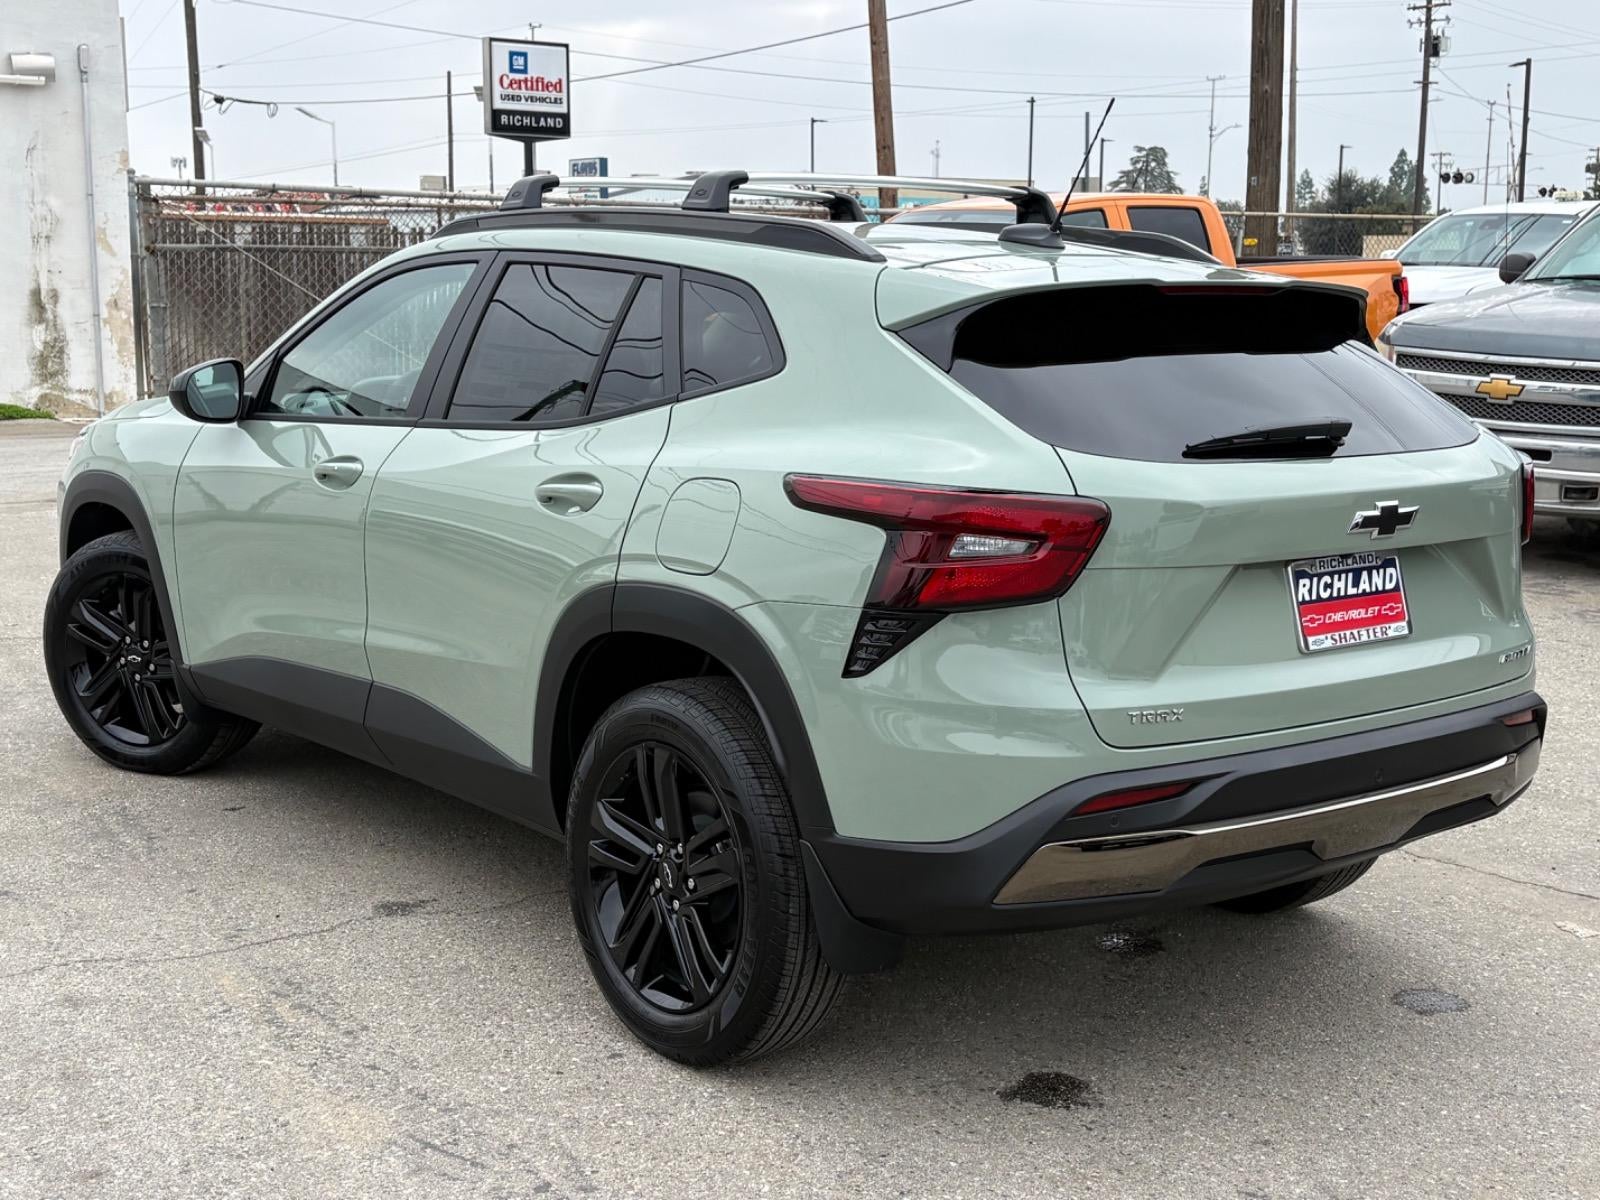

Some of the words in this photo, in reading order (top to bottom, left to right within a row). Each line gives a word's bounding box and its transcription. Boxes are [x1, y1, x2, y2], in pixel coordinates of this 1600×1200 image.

[513, 55, 524, 66] GM
[499, 74, 563, 93] Certified
[500, 94, 522, 102] USED
[523, 95, 564, 105] VEHICLES
[500, 114, 563, 128] RICHLAND
[1318, 554, 1374, 571] RICHLAND
[1297, 567, 1398, 602] RICHLAND
[1325, 606, 1381, 624] CHEVROLET
[1127, 707, 1184, 725] TRAX
